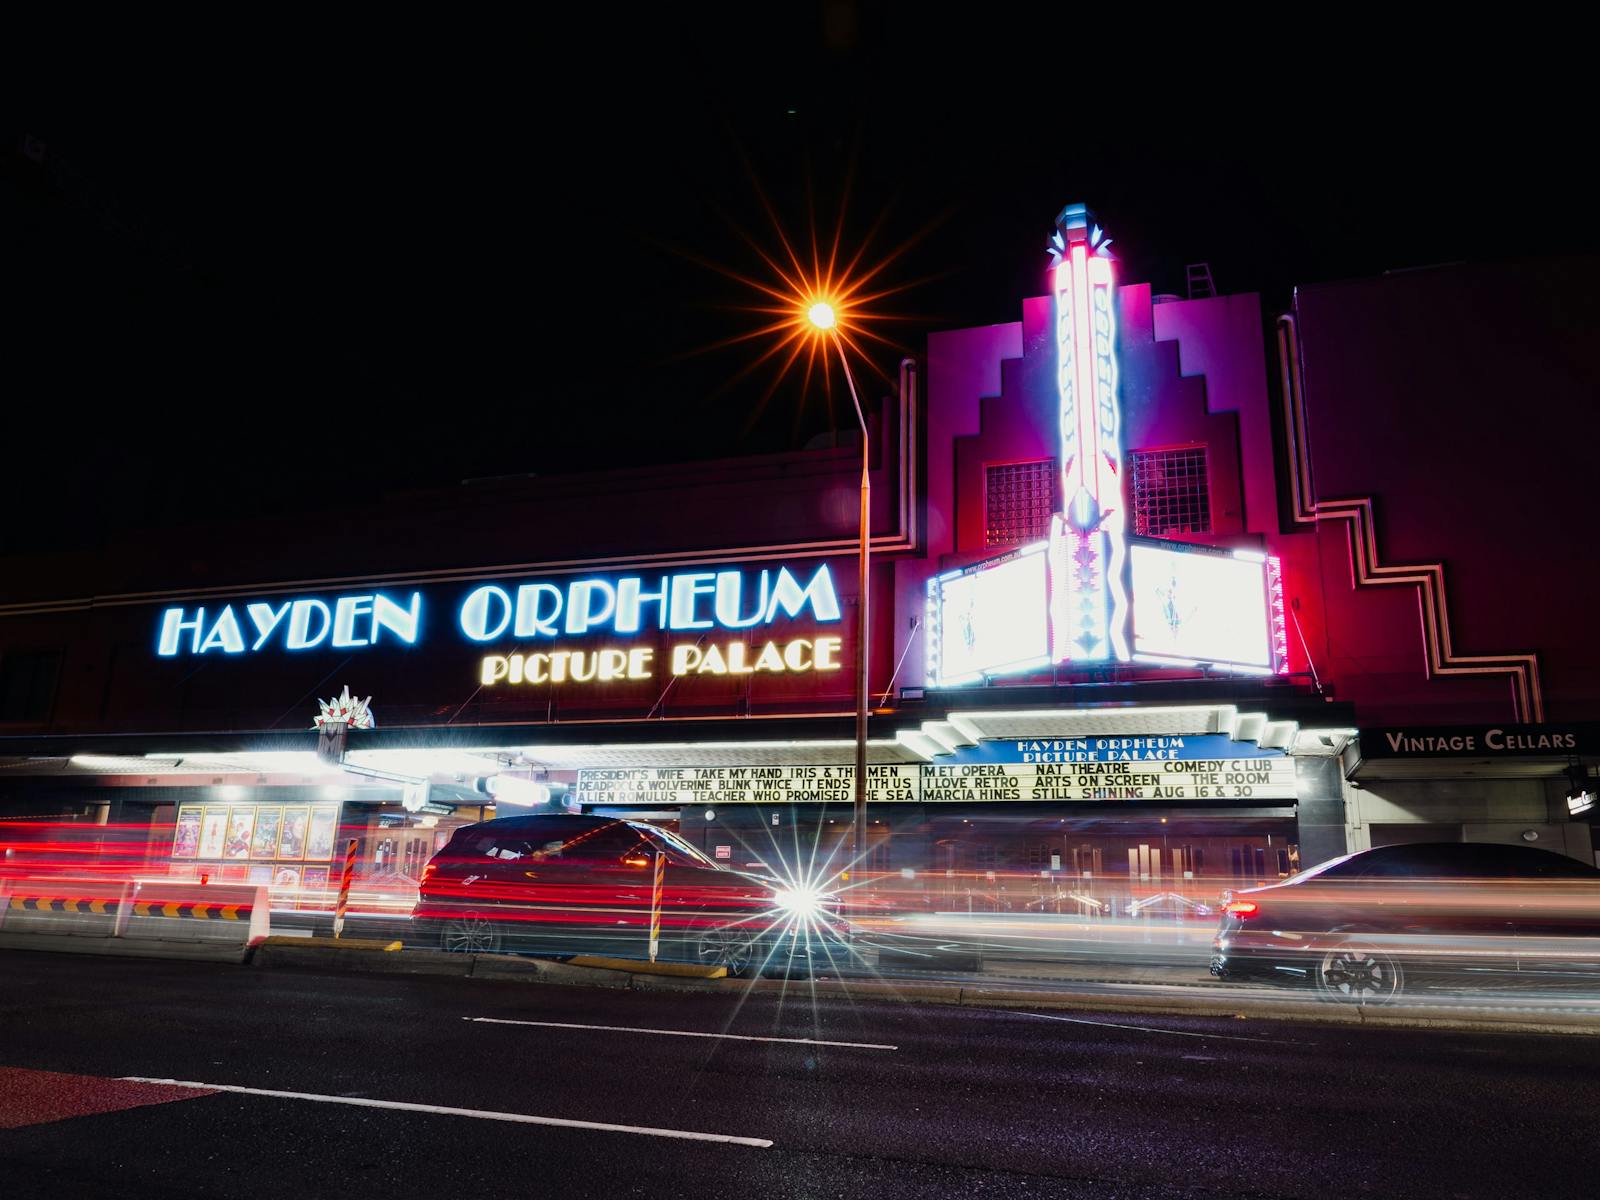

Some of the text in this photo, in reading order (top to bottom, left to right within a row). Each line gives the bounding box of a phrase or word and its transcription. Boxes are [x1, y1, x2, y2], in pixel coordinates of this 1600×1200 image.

[157, 562, 842, 656] HAYDEN ORPHEUM
[480, 636, 842, 686] PICTURE PALACE
[1017, 737, 1184, 752] HAYDEN ORPHEUM
[1386, 729, 1576, 752] VINTAGE CELLARS
[1023, 749, 1179, 763] PICTURE PALACE
[580, 769, 649, 780] PRESIDENT'S
[656, 769, 684, 780] WIFE
[694, 768, 725, 779] TAKE
[729, 768, 747, 779] MY
[751, 768, 782, 779] HAND
[790, 767, 817, 778] IRIS
[823, 767, 832, 778] &
[868, 766, 898, 777] MEN
[924, 759, 1272, 777] MET OPERA NAT THEATRE COMEDY CLUB
[636, 780, 644, 791] &
[648, 780, 712, 791] WOLVERINE
[718, 779, 751, 790] BLINK
[755, 779, 792, 790] TWICE
[802, 779, 813, 789] IT
[817, 779, 851, 789] ENDS
[865, 778, 889, 789] ITH
[893, 778, 911, 789] US
[935, 777, 968, 788] LOVE
[975, 776, 1019, 788] RETRO
[1035, 776, 1071, 787] ARTS
[1078, 775, 1098, 786] ON
[1104, 774, 1160, 786] SCREEN
[1191, 773, 1219, 784] THE
[1225, 772, 1270, 784] ROOM
[577, 789, 914, 802] ALIEN ROMULUS TEACHER WHO PROMISED HE SEA
[923, 785, 1253, 800] MARCIA HINES STILL SHINING AUG 16 & 30
